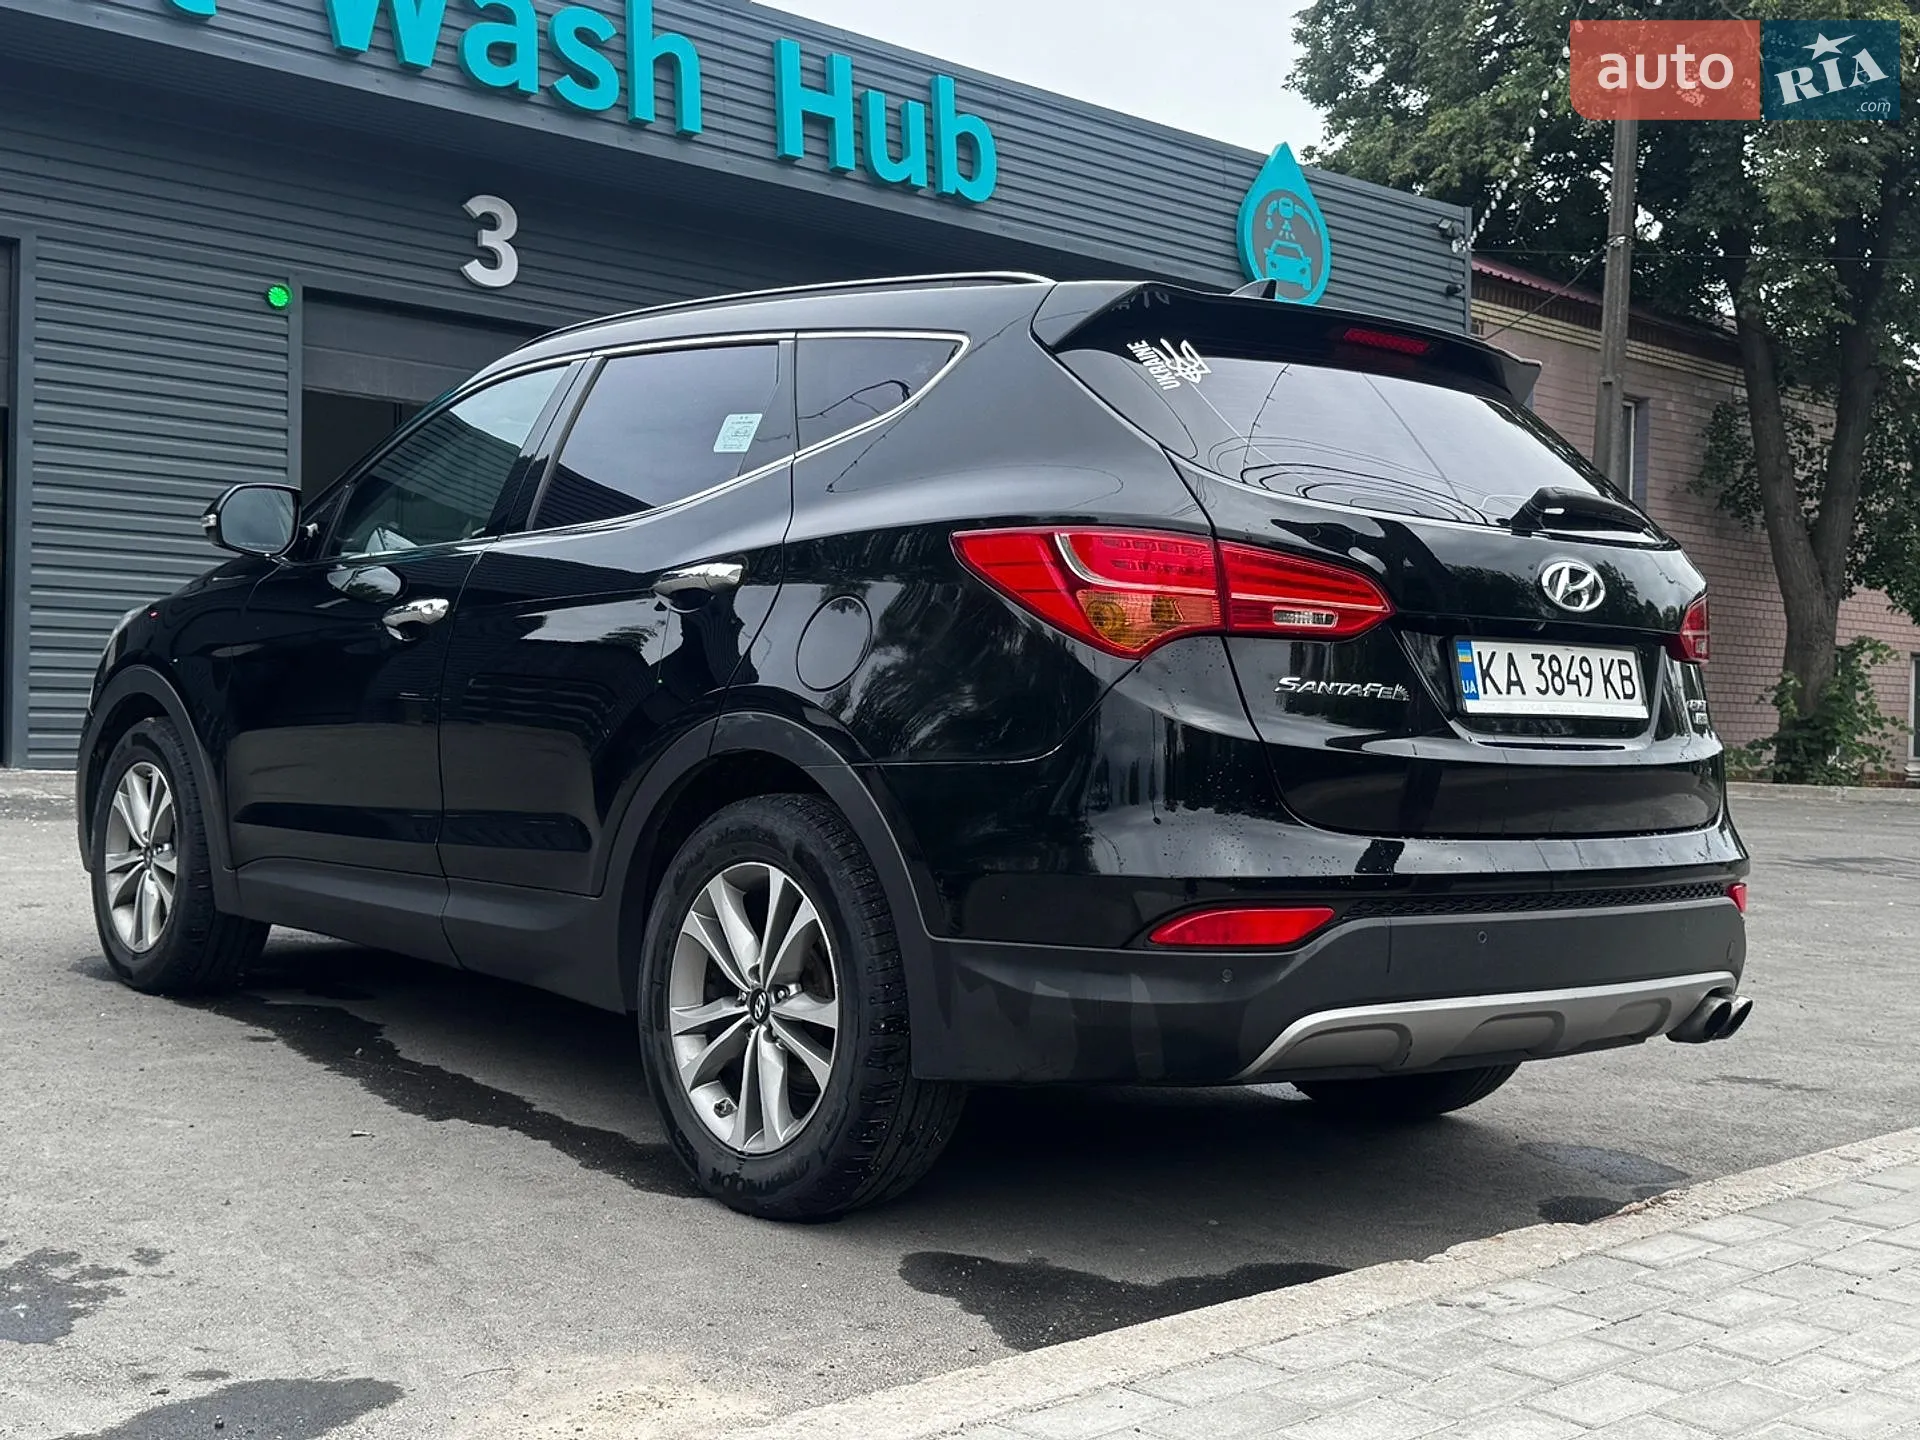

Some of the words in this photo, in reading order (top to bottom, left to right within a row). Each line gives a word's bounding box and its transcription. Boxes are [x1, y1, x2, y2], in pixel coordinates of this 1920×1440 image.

[774, 38, 997, 204] Hub
[460, 194, 518, 288] 3
[1126, 340, 1181, 390] UKRAINE
[1462, 680, 1477, 694] UA
[1477, 651, 1527, 696] KA
[1531, 653, 1594, 697] 3849
[1600, 658, 1637, 700] KB
